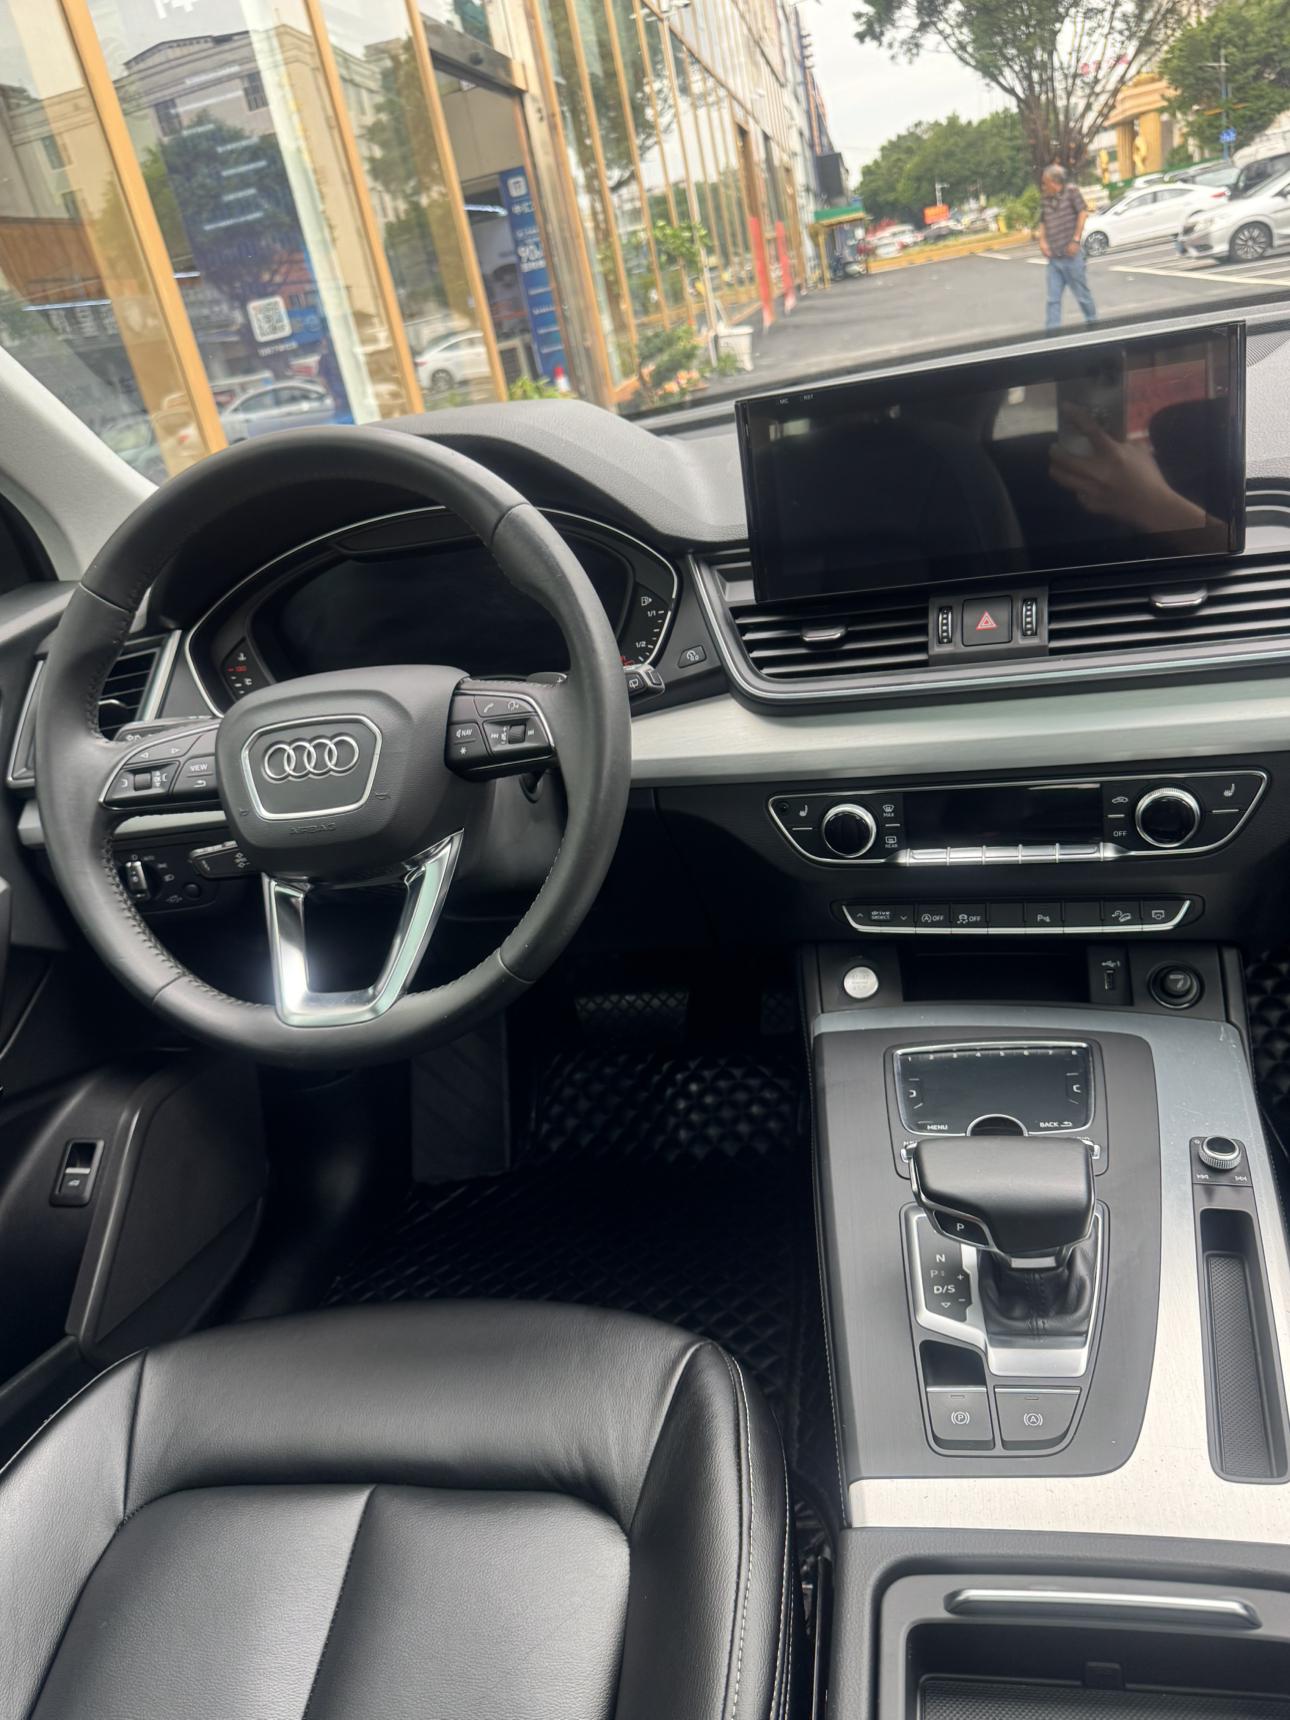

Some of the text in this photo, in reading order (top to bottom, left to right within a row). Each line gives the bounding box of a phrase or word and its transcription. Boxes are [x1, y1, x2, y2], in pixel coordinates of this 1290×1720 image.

[190, 763, 208, 772] VIEW
[956, 1223, 965, 1231] P
[936, 1254, 946, 1262] N
[933, 1284, 956, 1294] D/S
